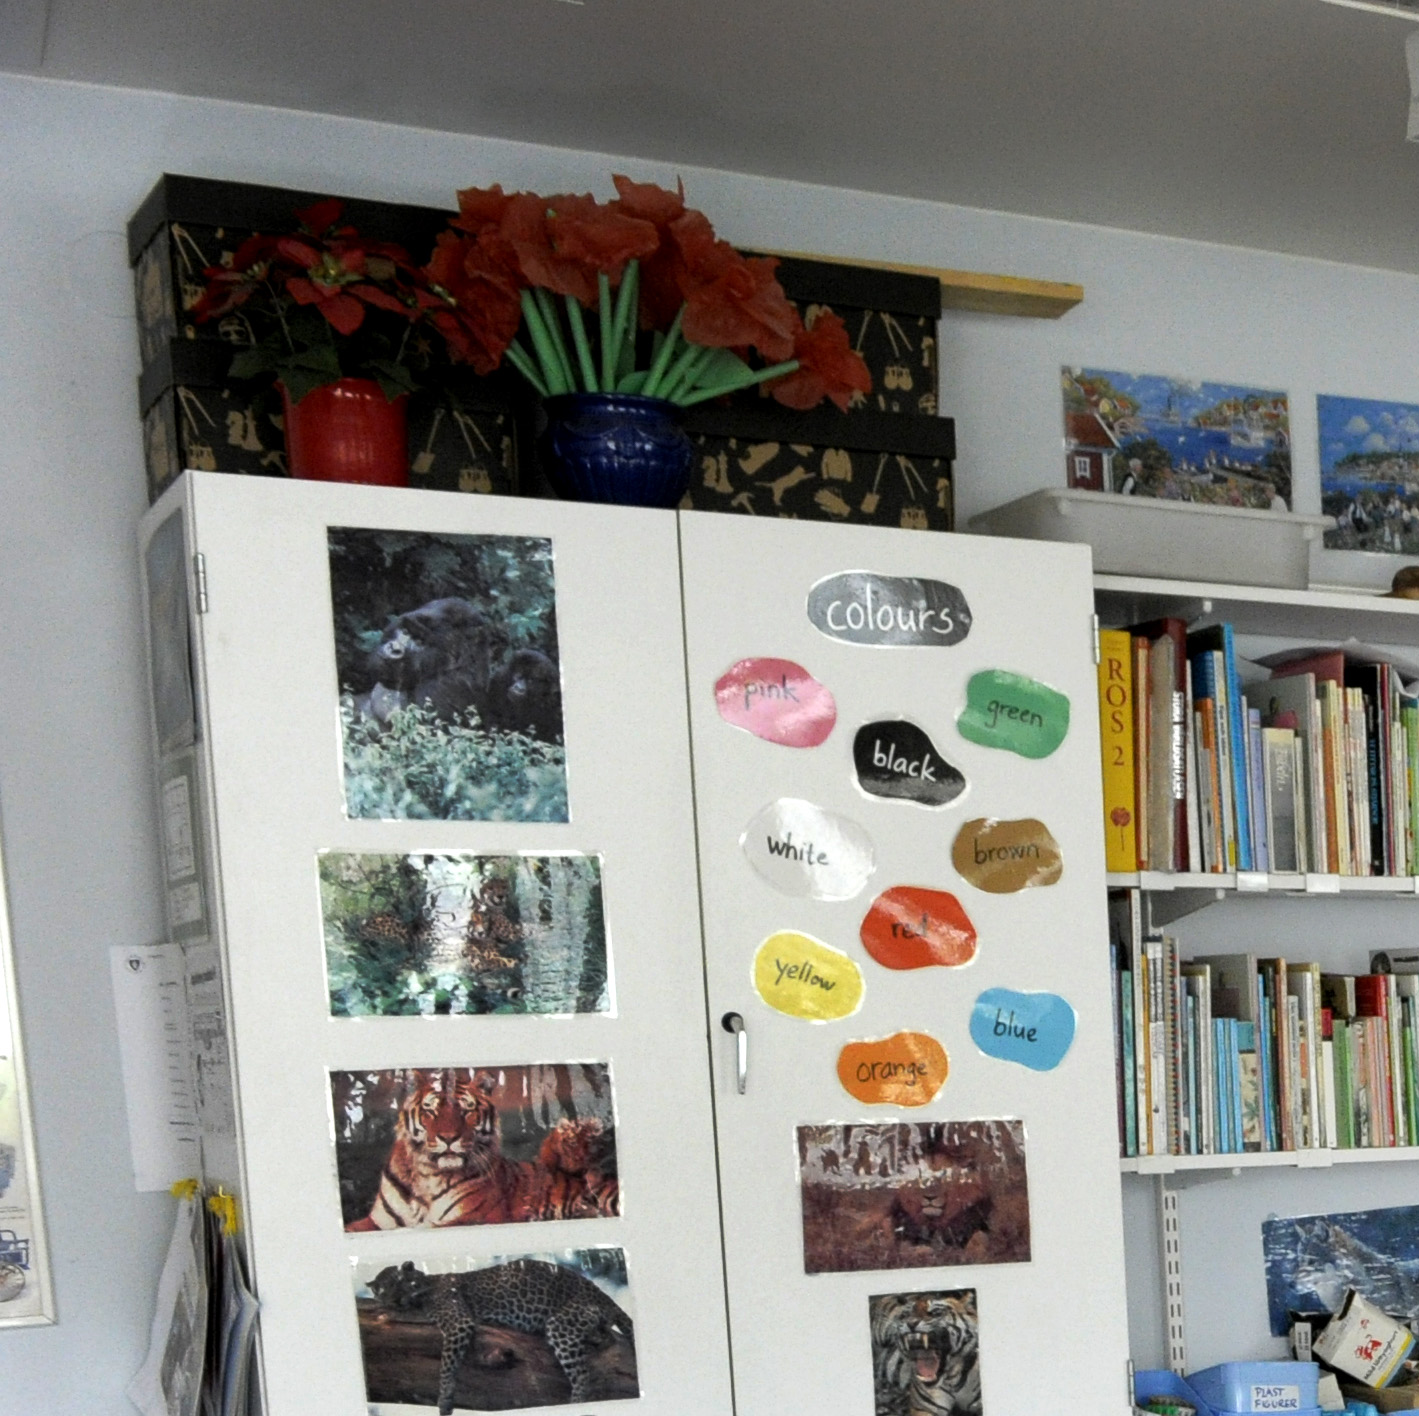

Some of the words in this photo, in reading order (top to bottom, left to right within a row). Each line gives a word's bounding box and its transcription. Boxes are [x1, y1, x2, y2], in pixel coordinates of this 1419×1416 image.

[826, 595, 955, 636] colours
[743, 674, 799, 709] pink
[986, 696, 1045, 728] green
[872, 739, 938, 782] black
[1111, 747, 1125, 766] 2
[767, 833, 830, 867] white
[973, 837, 1041, 865] brown
[890, 913, 929, 940] red
[774, 958, 837, 992] yellow
[992, 1008, 1039, 1042] blue
[855, 1057, 928, 1087] orange
[1254, 1386, 1285, 1398] PLAST
[1254, 1398, 1298, 1410] FIGURER
